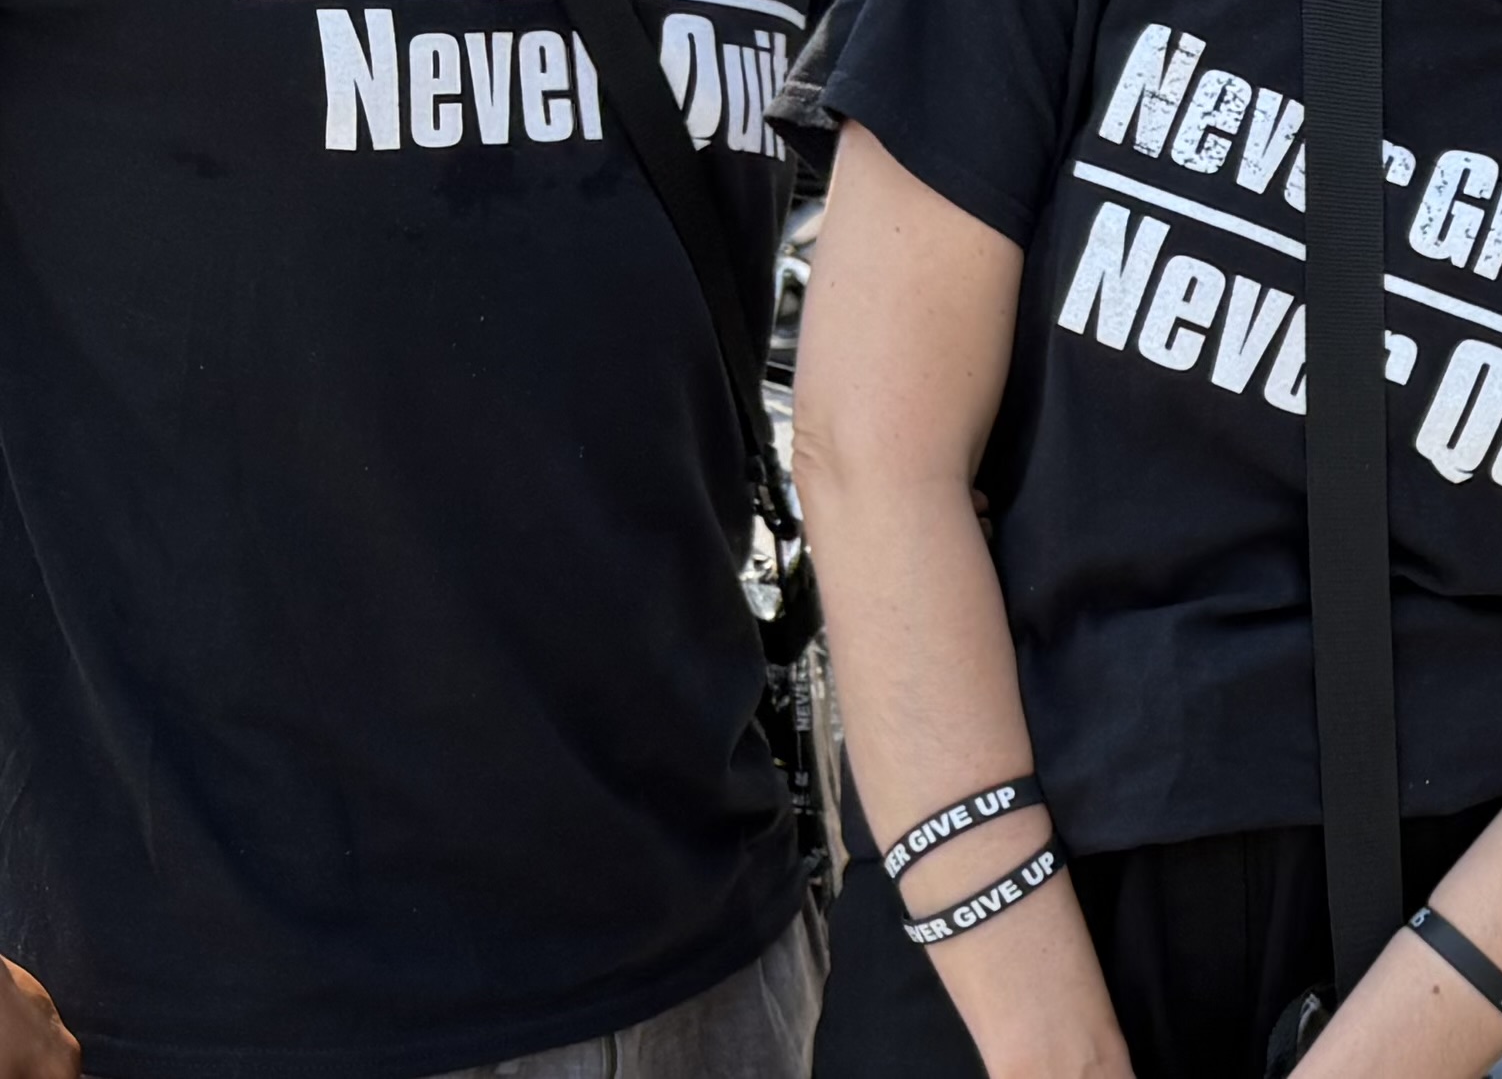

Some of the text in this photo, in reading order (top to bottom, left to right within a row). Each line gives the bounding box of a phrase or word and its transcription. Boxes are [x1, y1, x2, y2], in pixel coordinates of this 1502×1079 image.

[908, 804, 973, 853] GIVE
[974, 786, 1016, 816] UP
[953, 879, 1023, 928] GIVE
[1022, 851, 1055, 886] UP
